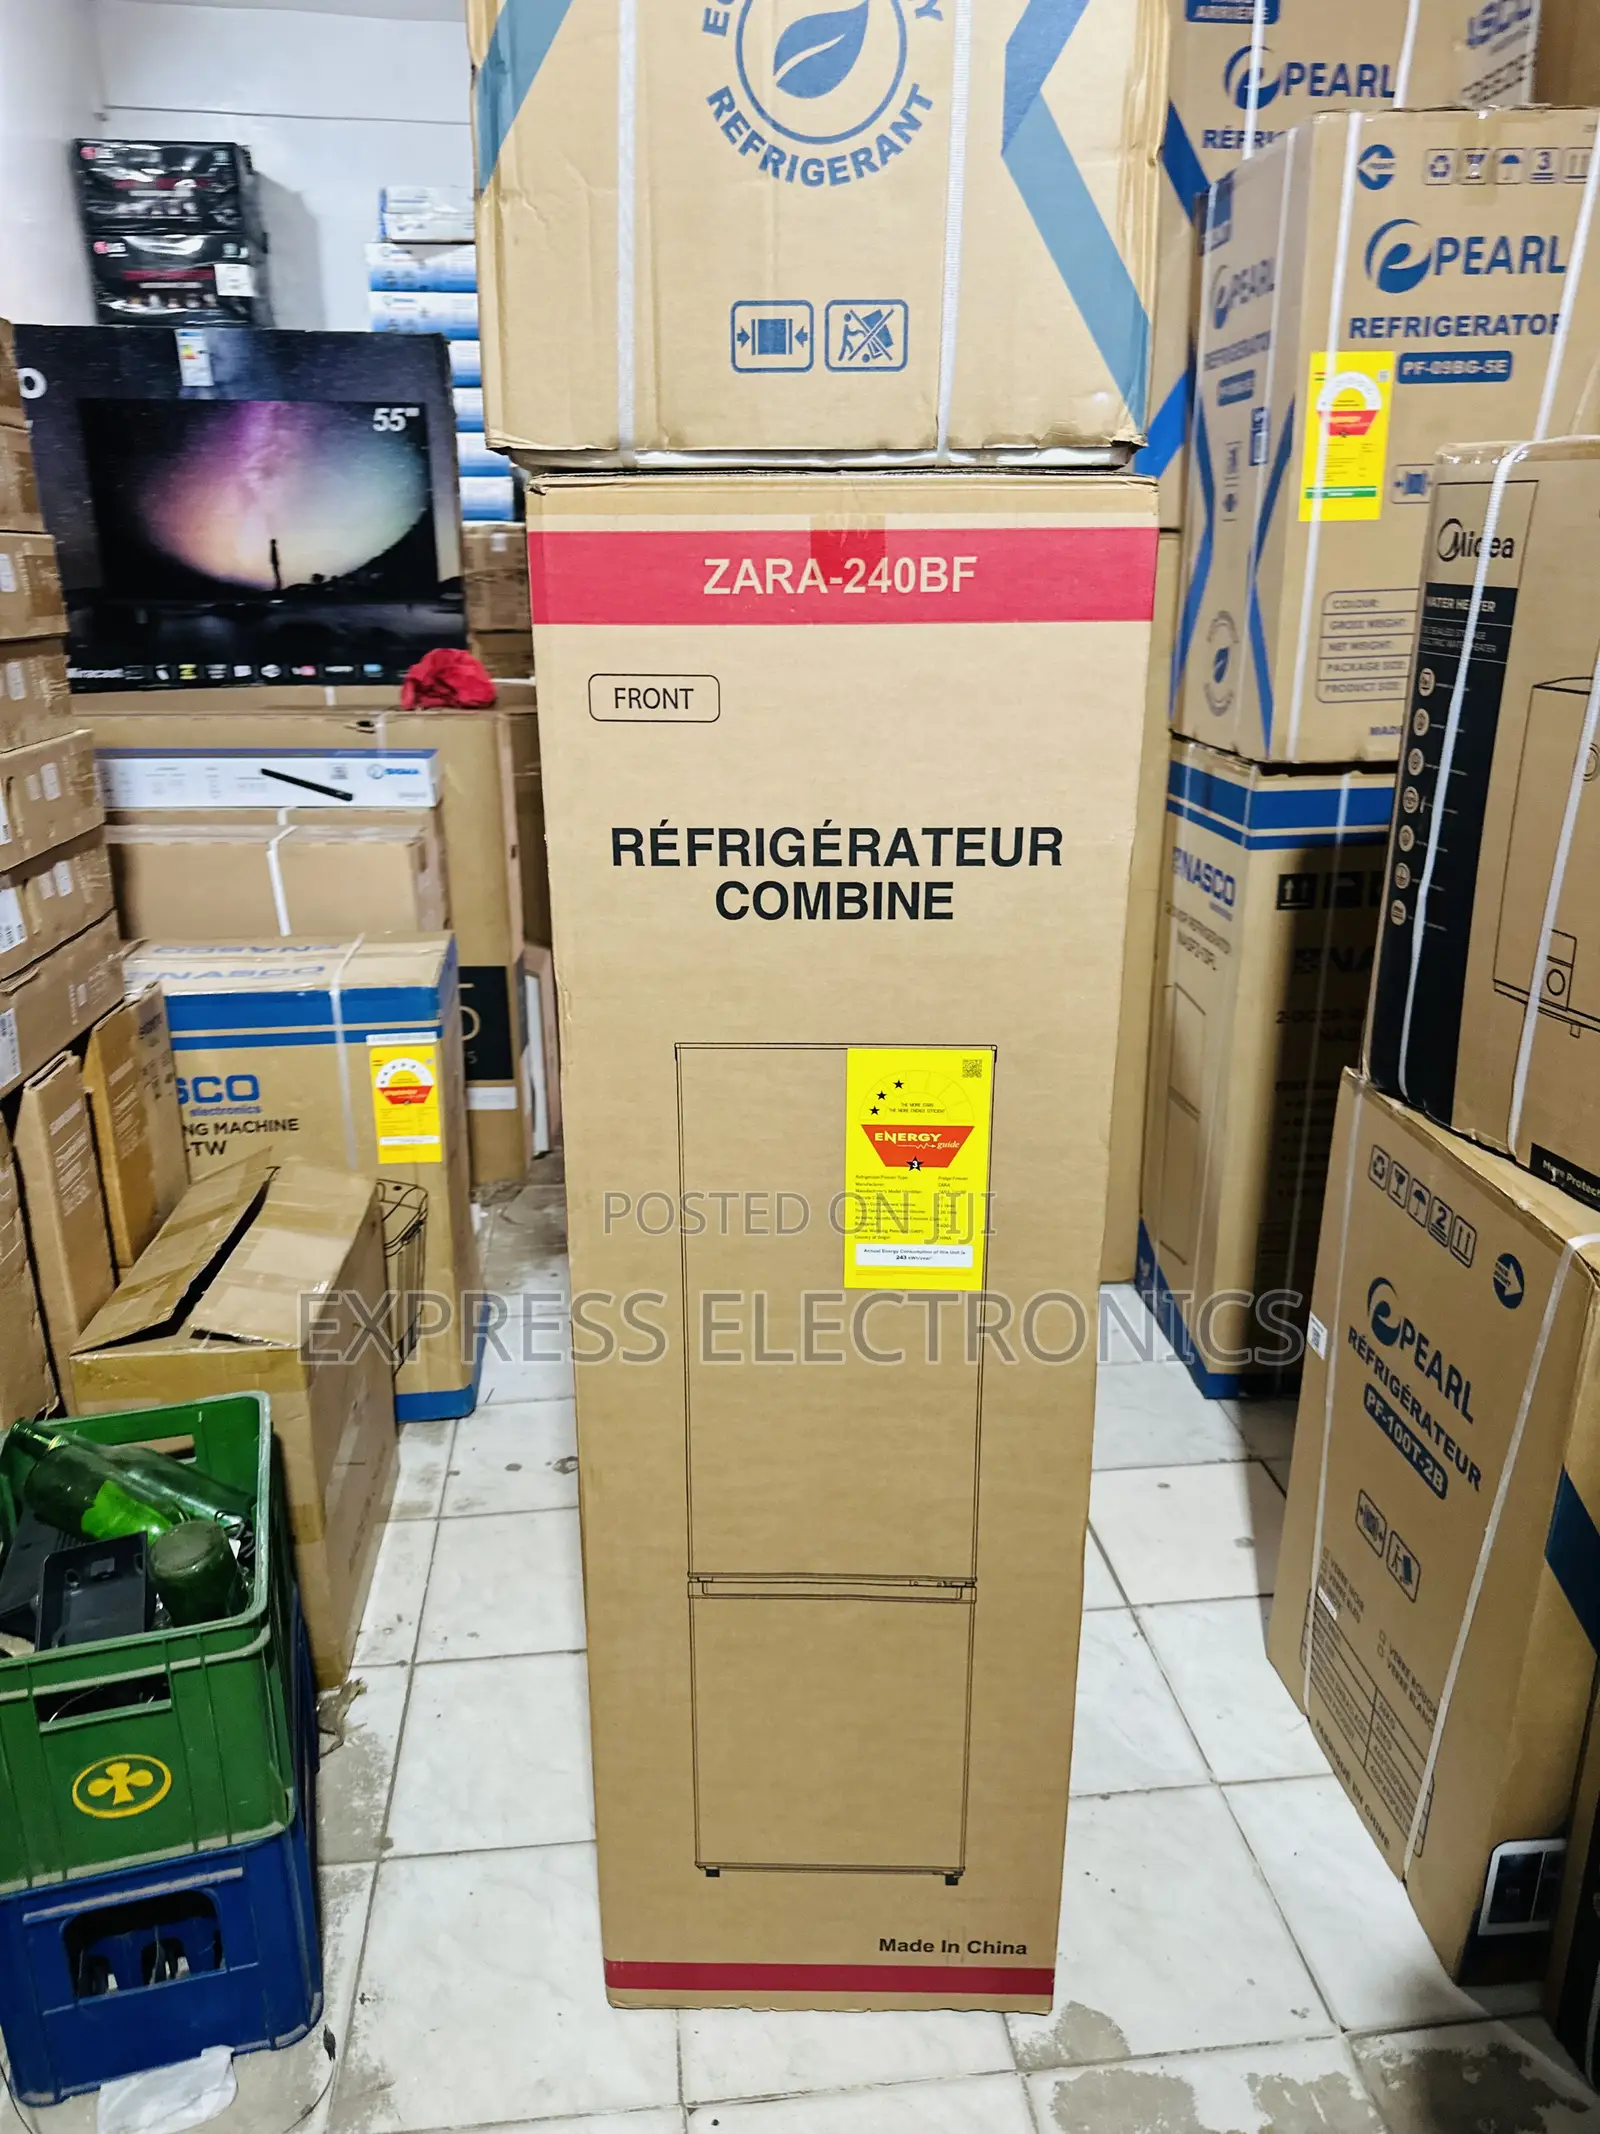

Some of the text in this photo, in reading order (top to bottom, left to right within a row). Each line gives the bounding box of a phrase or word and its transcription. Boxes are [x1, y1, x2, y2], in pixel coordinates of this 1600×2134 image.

[1283, 61, 1396, 98] PEARL
[706, 83, 934, 188] REFRIGERANT
[1434, 235, 1568, 275] PEARL
[704, 556, 977, 595] ZARA-240BF
[613, 687, 694, 711] FRONT
[610, 819, 1064, 868] RÉFRIGÉRATEUR
[715, 881, 955, 921] COMBINE
[213, 1118, 300, 1134] MACHINE
[874, 1130, 942, 1144] ENERGY
[1400, 1316, 1474, 1424] PEARL
[1348, 1325, 1482, 1492] RÉFRIGÉRATEUR
[1366, 1390, 1444, 1493] PF-100T-2B
[879, 1938, 1028, 1956] Made In China
